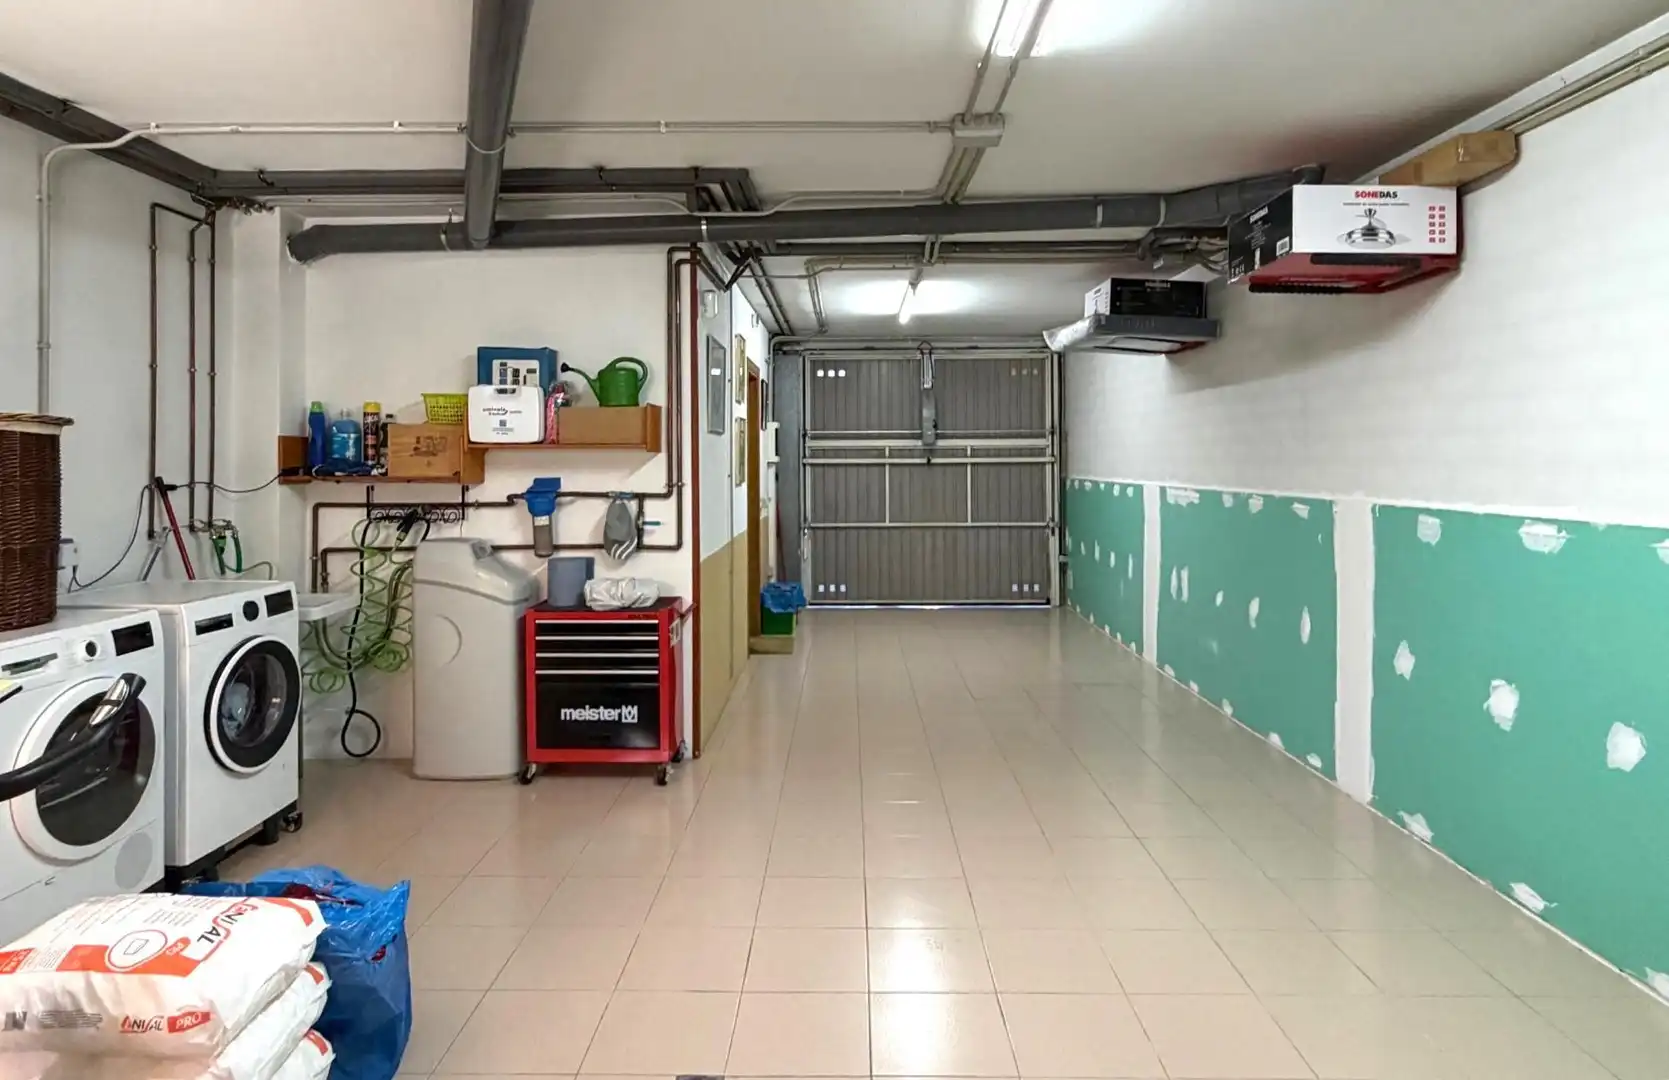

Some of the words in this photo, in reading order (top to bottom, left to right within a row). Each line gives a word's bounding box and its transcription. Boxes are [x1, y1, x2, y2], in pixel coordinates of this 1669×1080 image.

[1354, 190, 1398, 199] SONEDAS
[561, 704, 621, 721] meister
[175, 1011, 202, 1030] PRO
